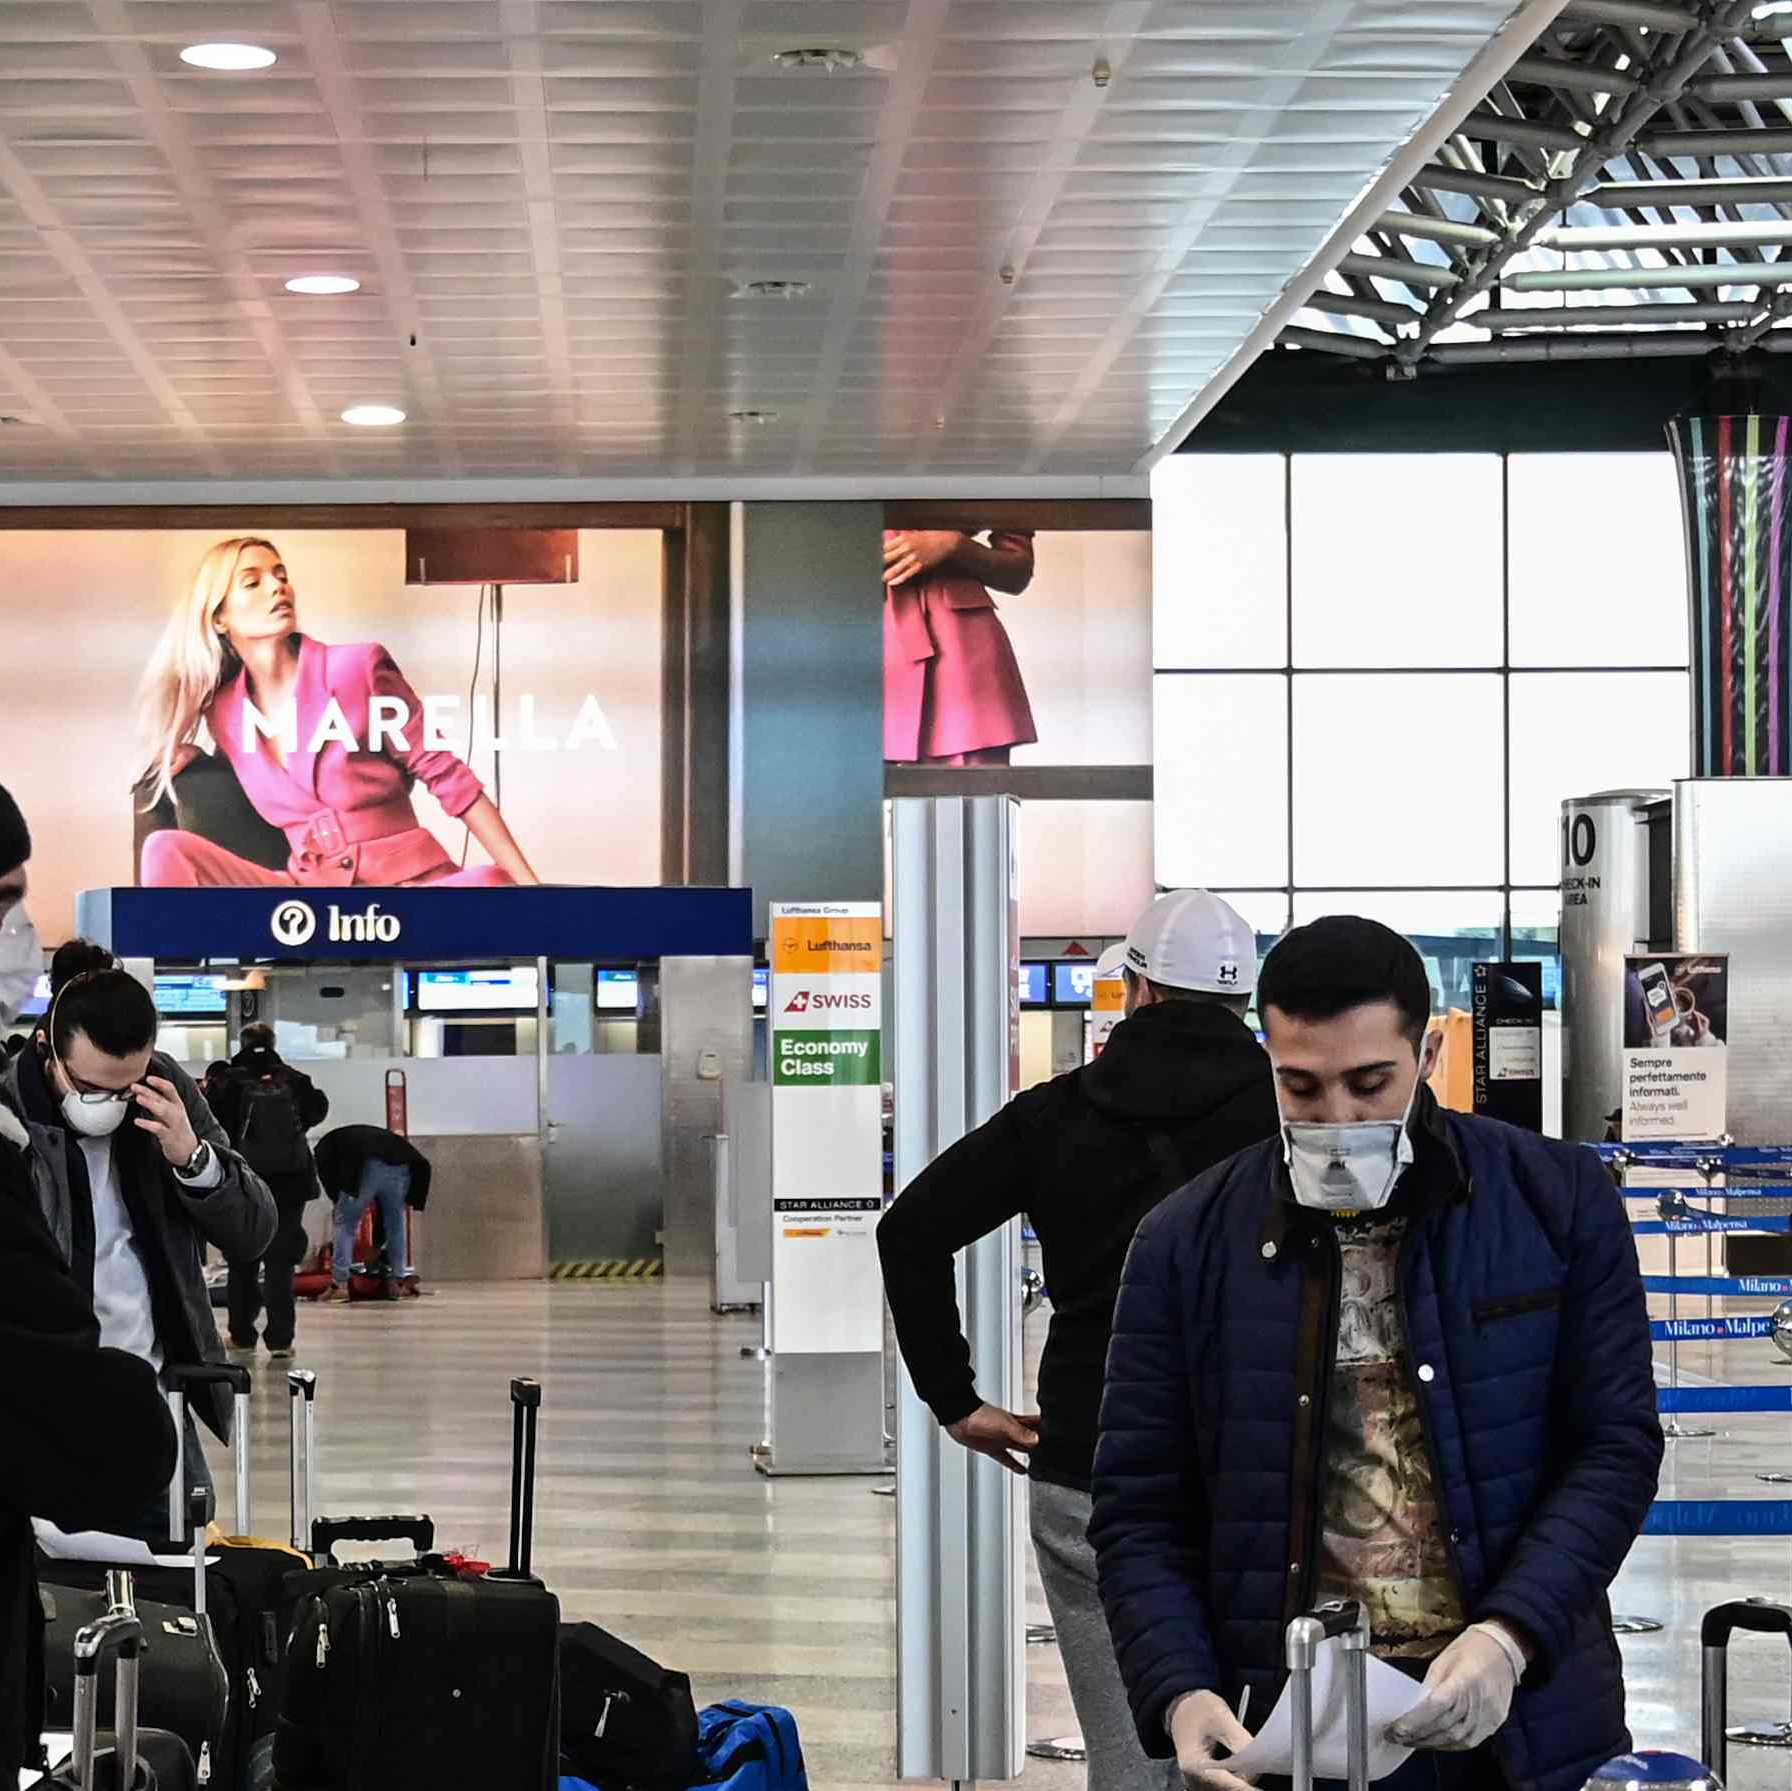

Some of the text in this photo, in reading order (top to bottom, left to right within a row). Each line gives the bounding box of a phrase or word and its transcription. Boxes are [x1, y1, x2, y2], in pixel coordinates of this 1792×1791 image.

[242, 694, 617, 754] MARELLA
[1563, 813, 1596, 866] 10
[327, 903, 401, 943] Info
[807, 939, 872, 952] Lufthansa
[812, 993, 872, 1009] SWISS
[780, 1038, 869, 1058] Economy
[1474, 984, 1488, 1104] STAR ALLIANCE
[780, 1059, 835, 1076] Class
[1630, 1057, 1673, 1070] Sempre
[1629, 1070, 1707, 1084] perfettamente
[1629, 1086, 1681, 1098] informati.
[1629, 1099, 1688, 1113] Always well
[1695, 1187, 1762, 1198] Milano Malpensa
[779, 1200, 862, 1210] STAR ALLIANCE
[1665, 1219, 1748, 1233] Milano Malpensa
[1738, 1278, 1782, 1293] Milano
[1664, 1318, 1770, 1340] Milano Malpe
